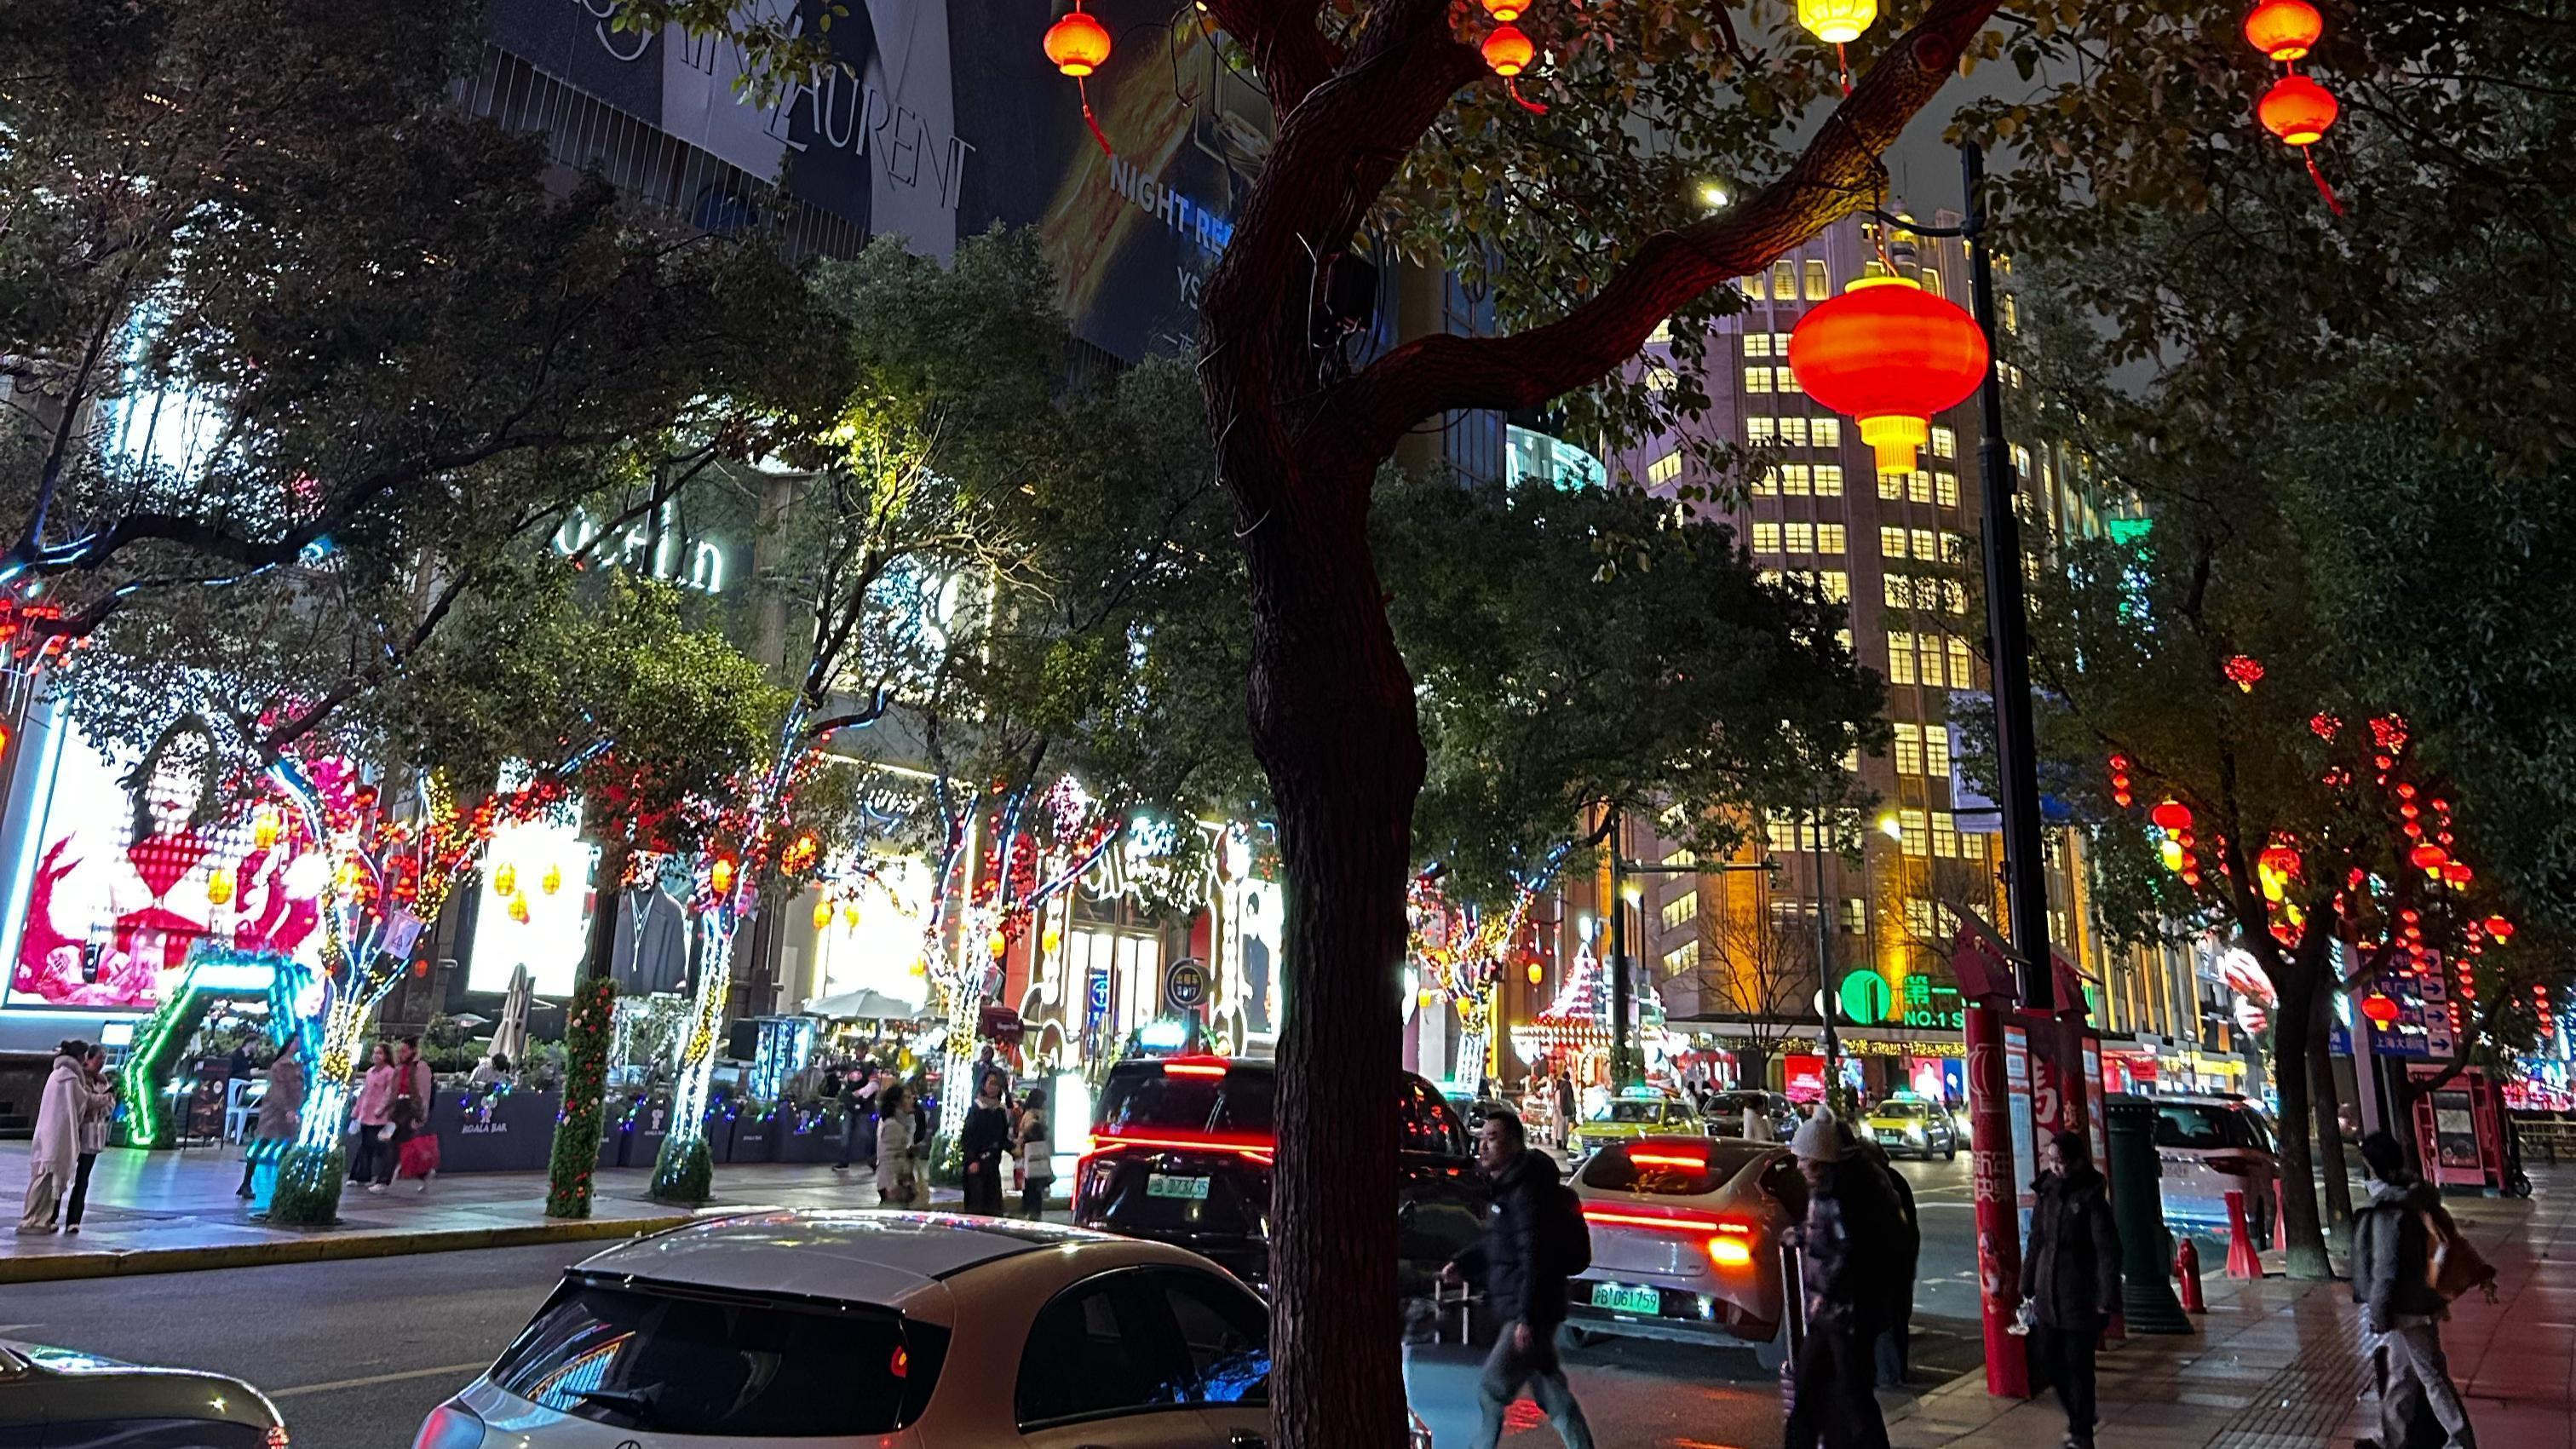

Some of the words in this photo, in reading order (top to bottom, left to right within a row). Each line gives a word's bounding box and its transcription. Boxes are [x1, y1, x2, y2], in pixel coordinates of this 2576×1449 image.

[1109, 159, 1190, 234] NIGHT
[1904, 1010, 1946, 1028] NO.1
[462, 1124, 489, 1134] KOALA
[491, 1123, 508, 1133] BAR
